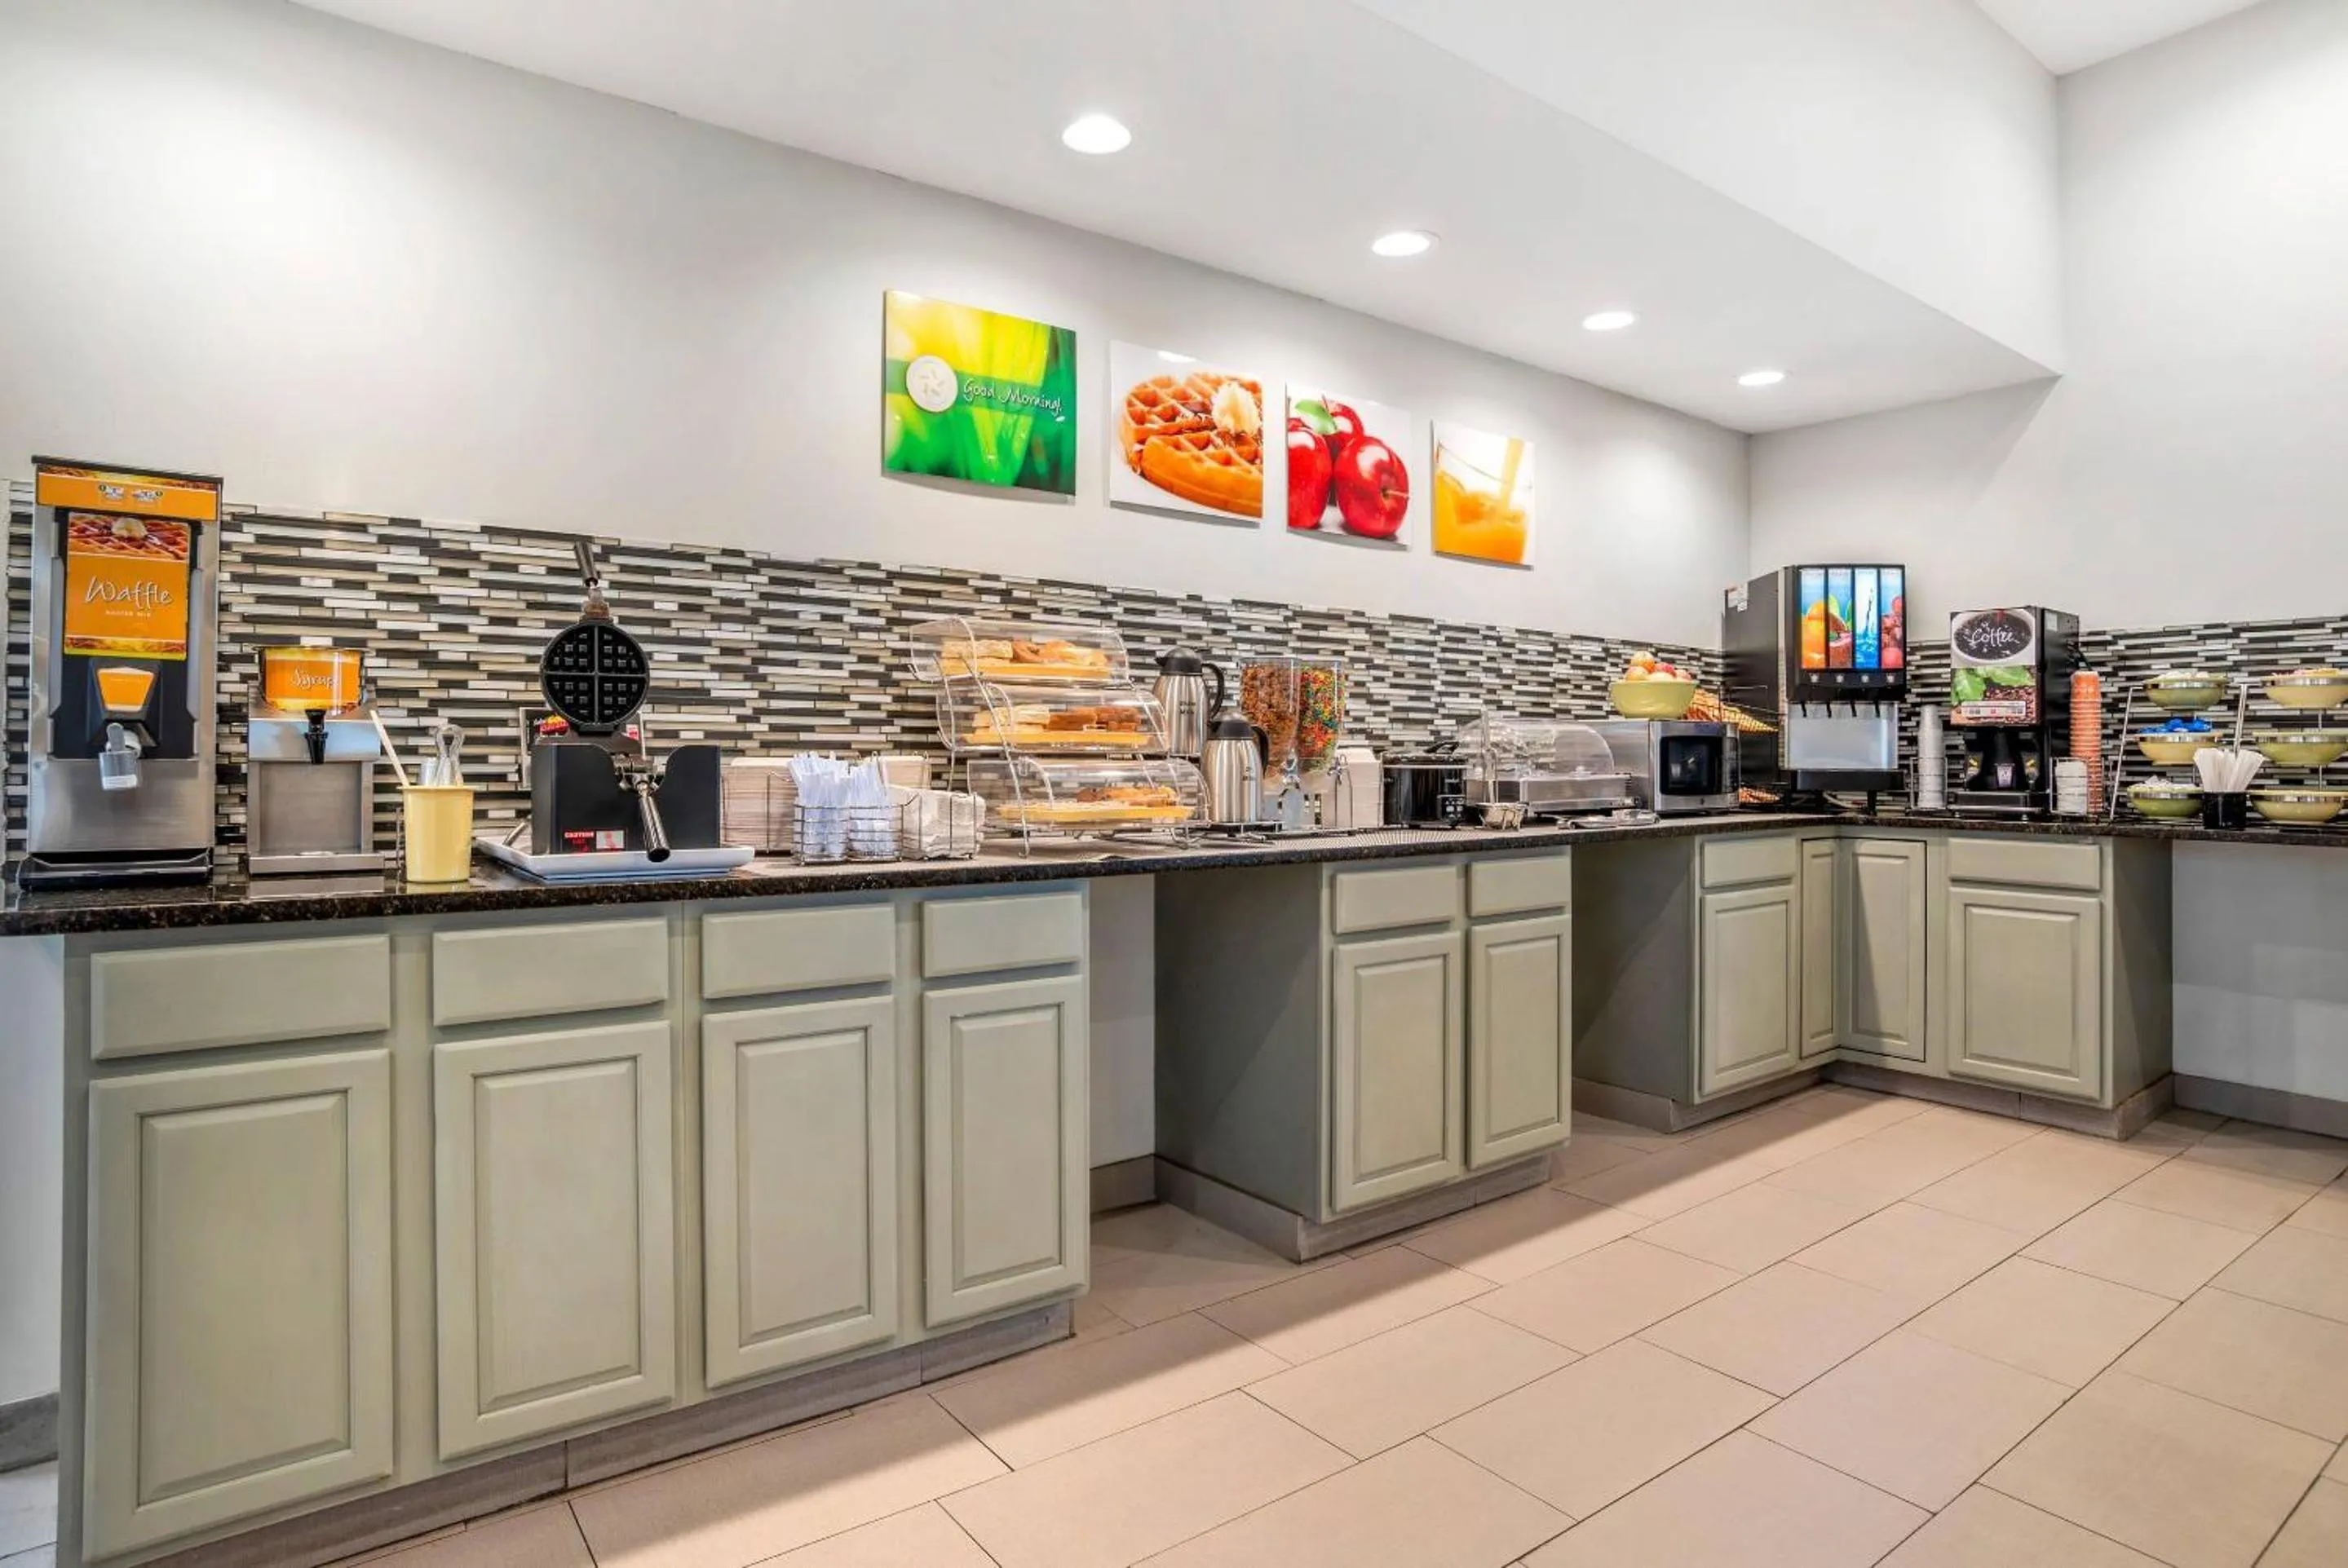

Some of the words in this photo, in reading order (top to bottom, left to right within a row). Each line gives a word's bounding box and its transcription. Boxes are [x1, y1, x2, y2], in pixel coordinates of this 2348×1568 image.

[963, 378, 996, 402] Good
[997, 387, 1063, 418] Morning!
[85, 575, 174, 610] Waffle
[1966, 625, 2019, 647] Coffee
